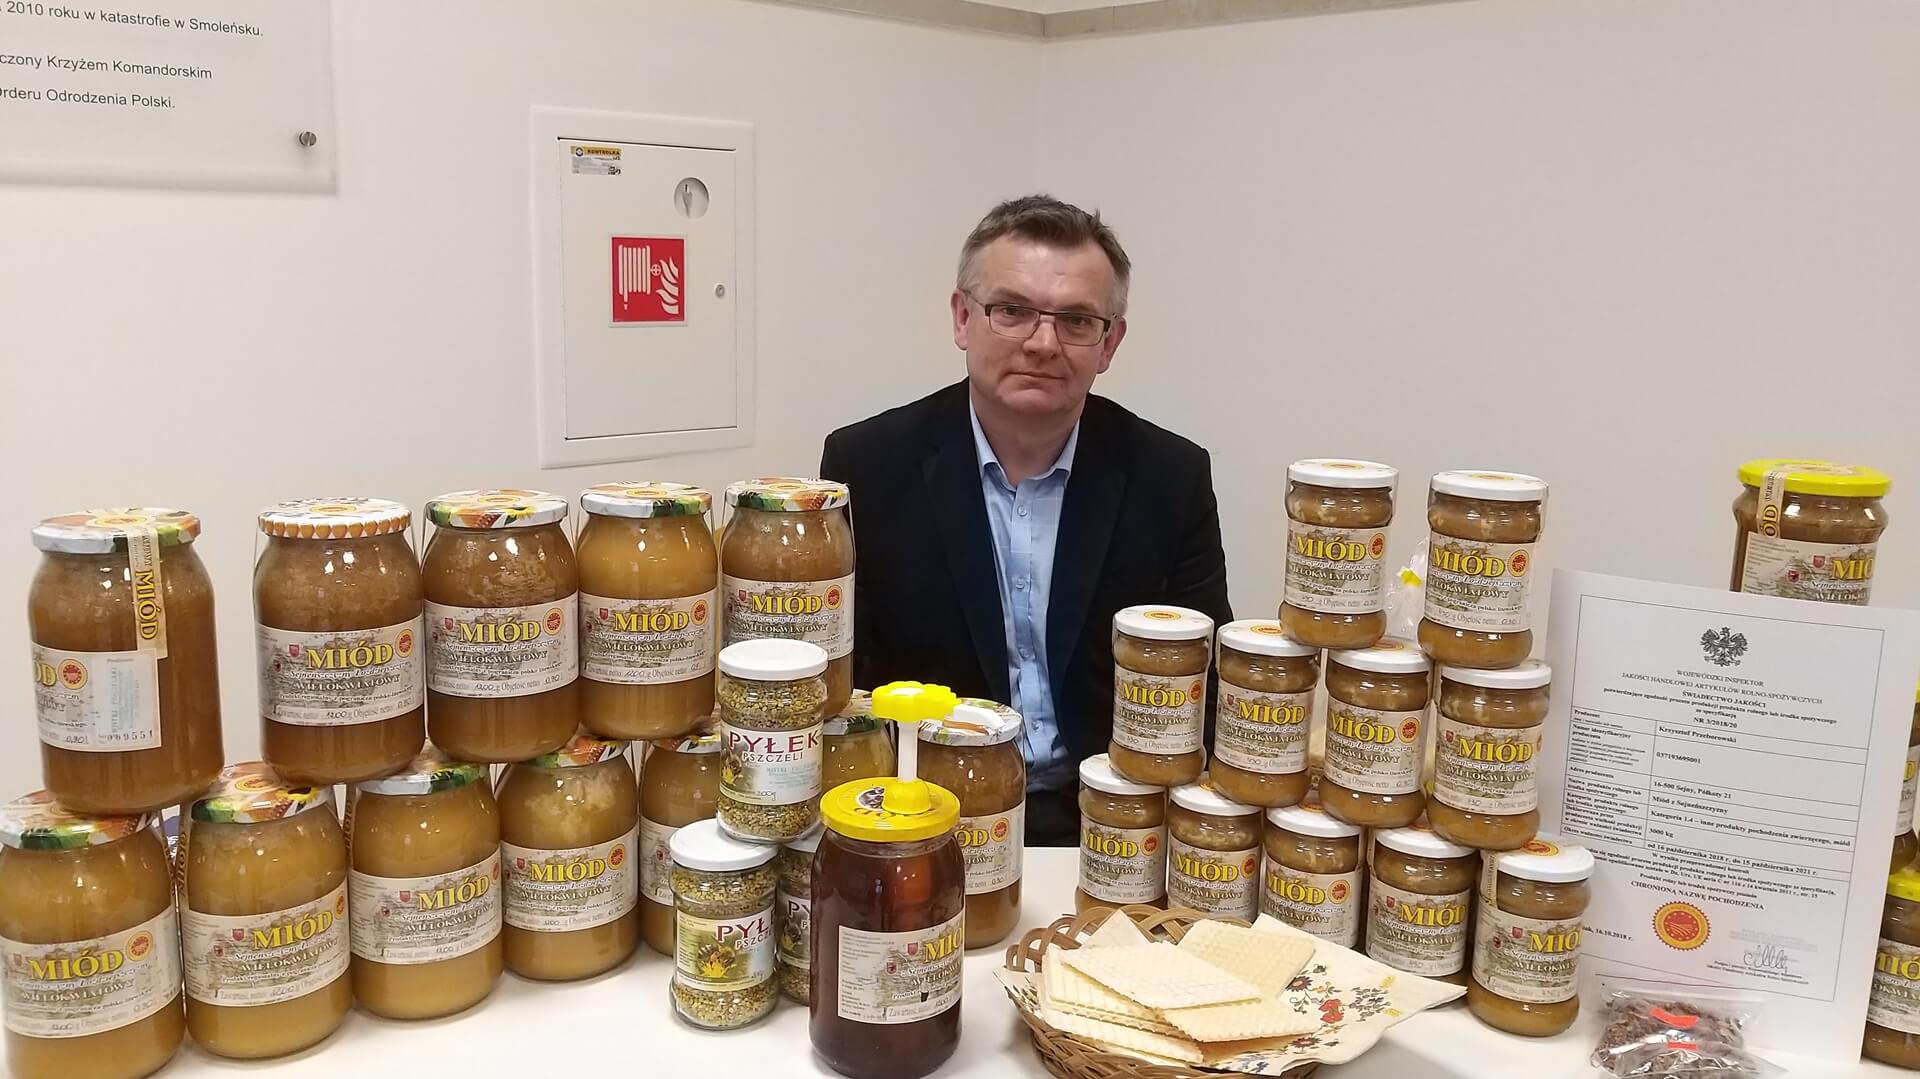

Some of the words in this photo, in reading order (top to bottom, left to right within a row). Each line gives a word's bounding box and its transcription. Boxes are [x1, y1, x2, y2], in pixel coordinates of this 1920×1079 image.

[7, 1, 44, 16] 2010
[48, 6, 80, 20] roku
[84, 10, 95, 20] w
[100, 9, 171, 28] katastrofie
[175, 18, 185, 29] w
[189, 17, 264, 37] Smoleńsku.
[47, 55, 109, 72] Krzyżem
[113, 59, 213, 79] Komandorskim
[0, 87, 41, 101] rderu
[46, 88, 127, 107] Odrodzenia
[132, 95, 175, 109] Polski.
[1760, 504, 1778, 538] ÓD
[1294, 535, 1367, 562] MIÓD
[1432, 547, 1506, 577] MIÓD
[135, 569, 161, 640] MIÓD
[751, 591, 823, 616] MIÓD
[458, 617, 542, 644] MIÓD
[614, 607, 690, 633] MIÓD
[306, 640, 394, 670] MIÓD
[34, 659, 57, 687] ÓD
[1622, 672, 1649, 681] JAKOŚCI
[1650, 676, 1693, 687] HANDLOWEJ
[1694, 682, 1739, 694] ARTYKUŁÓW
[1676, 670, 1723, 682] WOJEWÓDZKI
[1725, 676, 1764, 687] INSPEKTOR
[1122, 681, 1186, 707] MIÓD
[1682, 690, 1733, 703] ŚWIADECTWO
[1734, 698, 1766, 708] JAKOŚCI
[1238, 700, 1306, 726] MIÓD
[1329, 713, 1396, 744] MIÓD
[1659, 726, 1691, 737] Krzysztof
[1692, 731, 1737, 743] Przeborowski
[729, 731, 819, 754] PYŁEK
[1457, 736, 1533, 764] MIÓD
[741, 751, 803, 763] PSZCZELI
[1652, 795, 1670, 804] Miód
[955, 825, 989, 848] ÓD
[1650, 810, 1682, 821] Kategoria
[1715, 822, 1746, 833] produkty
[1748, 826, 1789, 839] pochodzenia
[1081, 830, 1139, 858] MIÓD
[530, 857, 605, 883] MIÓD
[1176, 853, 1239, 882] MIÓD
[1665, 846, 1707, 859] października
[1708, 853, 1724, 861] 2018
[1751, 861, 1794, 873] października
[417, 874, 491, 912] MIÓD
[1266, 871, 1327, 906] MIÓD
[1631, 880, 1677, 896] CHRONIONĄ
[1679, 890, 1706, 901] NAZWĘ
[1707, 895, 1764, 910] POCHODZENIA
[251, 908, 334, 951] MIÓD
[716, 917, 769, 942] PYŁ
[1526, 929, 1582, 953] MIÓ
[28, 949, 124, 982] MIÓD
